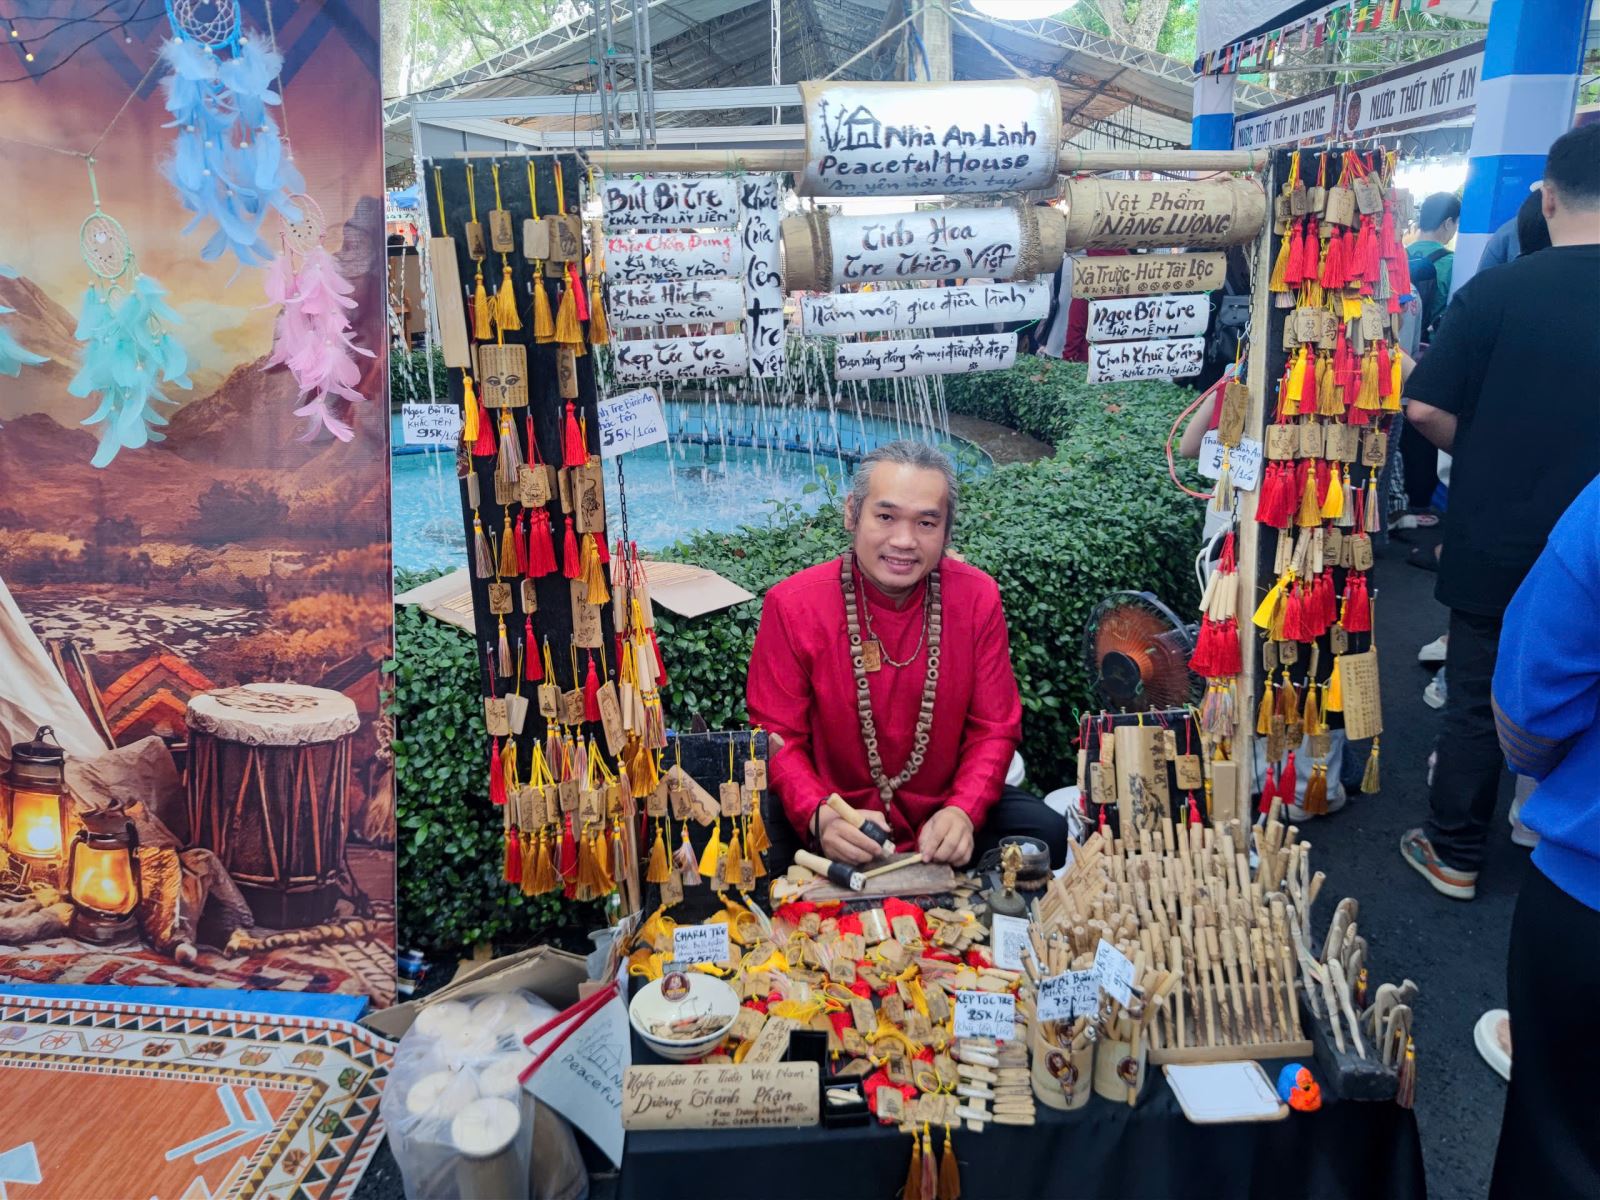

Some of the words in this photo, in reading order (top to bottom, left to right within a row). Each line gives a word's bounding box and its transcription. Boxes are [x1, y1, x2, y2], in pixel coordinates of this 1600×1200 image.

[1369, 88, 1396, 122] NƯỚC
[1399, 76, 1428, 115] THỐT
[1429, 68, 1455, 107] NỐT
[1457, 66, 1477, 101] AN
[884, 124, 936, 148] Nhà
[942, 124, 976, 147] An
[977, 121, 1037, 147] Lành
[1237, 124, 1254, 148] NƯỚC
[1255, 118, 1272, 144] THỐT
[1273, 113, 1289, 141] NỐT
[1289, 113, 1301, 136] AN
[1302, 106, 1326, 133] GIANG
[818, 150, 939, 176] Peaceful
[940, 150, 1030, 174] House
[607, 182, 649, 213] Bút
[653, 182, 679, 212] Bi
[682, 181, 722, 209] Tre
[1105, 191, 1141, 213] Vật
[1147, 189, 1205, 211] Phẩm
[861, 218, 914, 251] Tinh
[927, 216, 977, 246] Hoa
[1098, 212, 1164, 235] NĂNG
[1163, 213, 1231, 237] LƯỢNG
[843, 251, 884, 279] Tre
[896, 247, 962, 275] Thiền
[963, 243, 1016, 274] Việt
[1075, 266, 1094, 285] Xả
[1166, 262, 1187, 279] Tài
[1188, 258, 1214, 280] Lộc
[859, 296, 899, 323] mới
[1093, 307, 1132, 329] Ngọc
[1165, 300, 1195, 319] Tre
[618, 345, 653, 370] Kẹp
[689, 340, 725, 361] Tre
[838, 355, 860, 371] Bạn
[883, 347, 906, 373] đáng
[984, 339, 1009, 363] đẹp
[403, 406, 425, 420] Ngọc
[432, 416, 452, 427] TÊN
[599, 419, 616, 430] hắc
